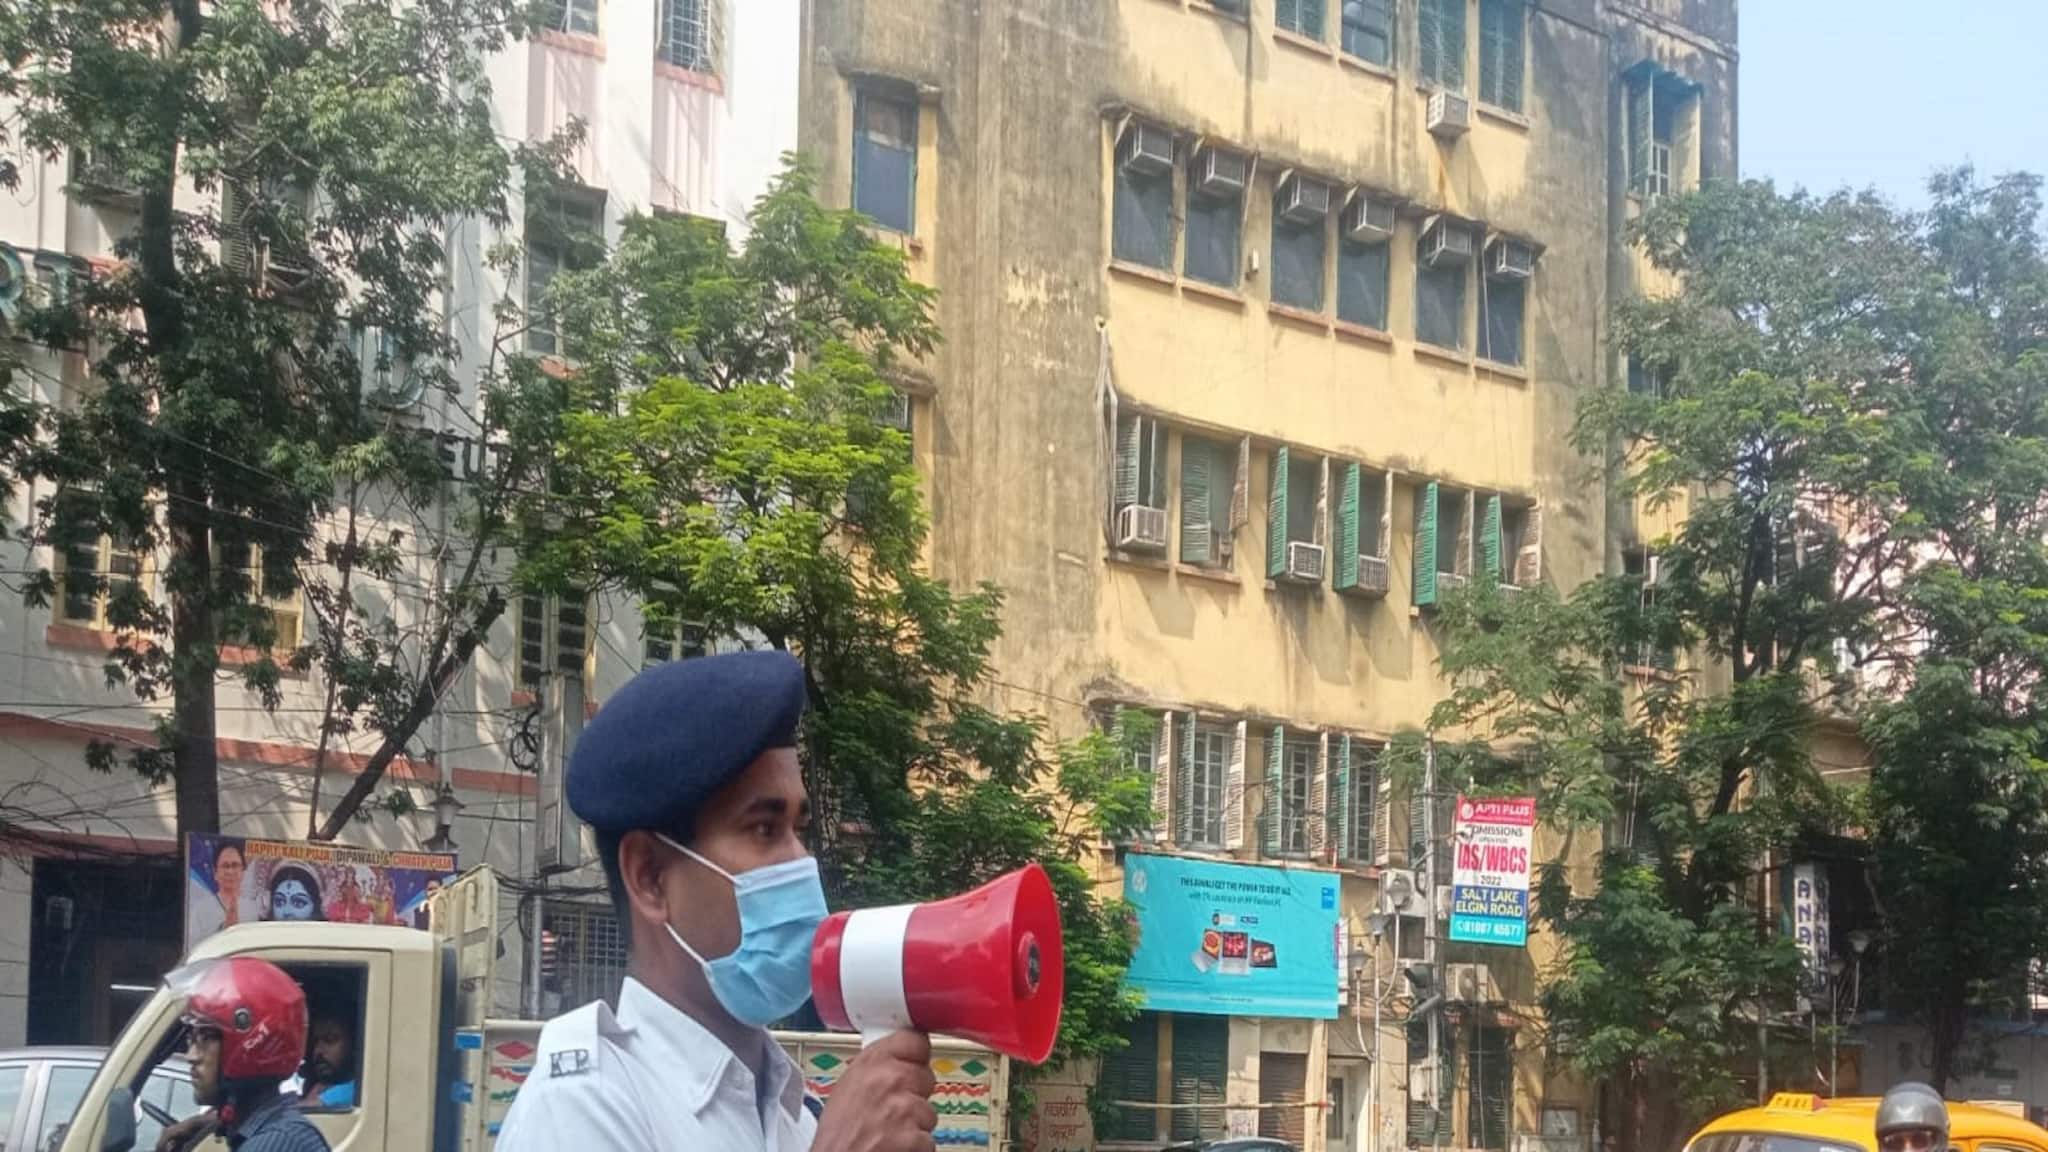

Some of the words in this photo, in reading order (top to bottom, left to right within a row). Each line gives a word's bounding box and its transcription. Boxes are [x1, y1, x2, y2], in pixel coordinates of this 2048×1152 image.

[1475, 803, 1501, 814] APTI
[1503, 804, 1530, 816] PLUS
[1464, 825, 1523, 838] DMISSIONS
[1457, 843, 1527, 874] IAS/WBCS
[1462, 888, 1489, 901] SALT
[1490, 890, 1519, 904] LAKE
[1456, 900, 1488, 915] ELGIN
[1490, 903, 1523, 918] ROAD
[549, 1048, 590, 1078] KP
